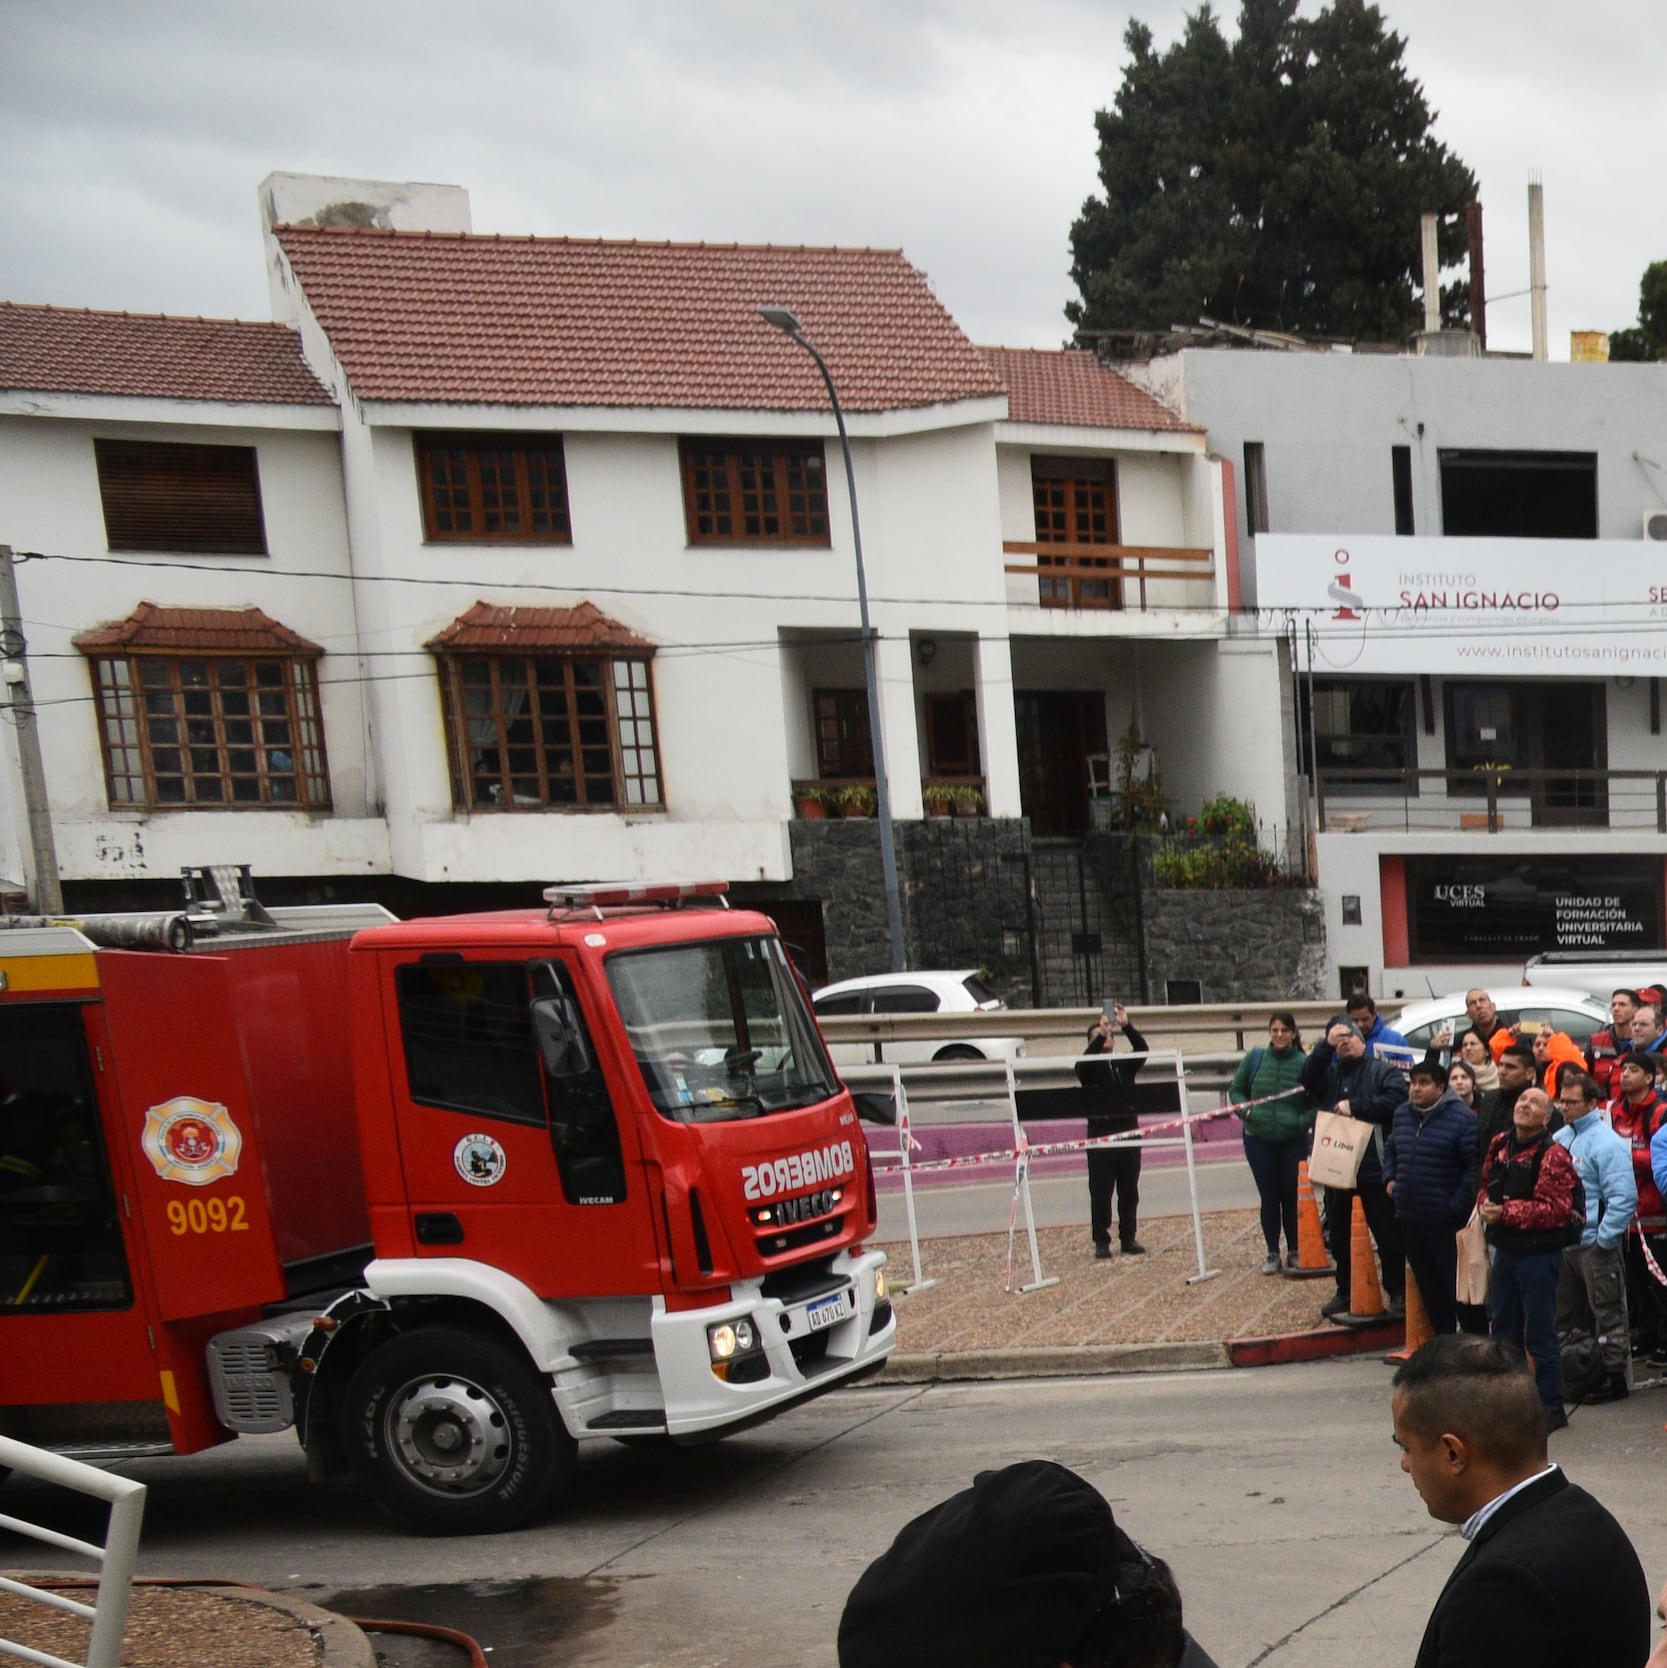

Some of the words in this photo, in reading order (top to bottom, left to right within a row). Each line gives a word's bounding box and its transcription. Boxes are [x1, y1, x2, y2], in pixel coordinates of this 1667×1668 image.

[1399, 574, 1476, 588] INSTITUTO
[1400, 592, 1448, 610] SAN
[1456, 592, 1560, 612] IGNACIO
[1649, 607, 1660, 618] A
[1434, 885, 1486, 900] UCES
[1450, 899, 1486, 908] VIRTUAL
[1556, 897, 1602, 908] UNIDAD
[1604, 897, 1621, 908] DE
[1556, 908, 1627, 920] FORMACIÓN
[1556, 921, 1644, 933] UNIVERSITARIA
[1557, 934, 1606, 945] VIRTUAL
[579, 1197, 614, 1205] IVECAM
[777, 1189, 834, 1228] IVECO
[167, 1195, 249, 1236] 9092
